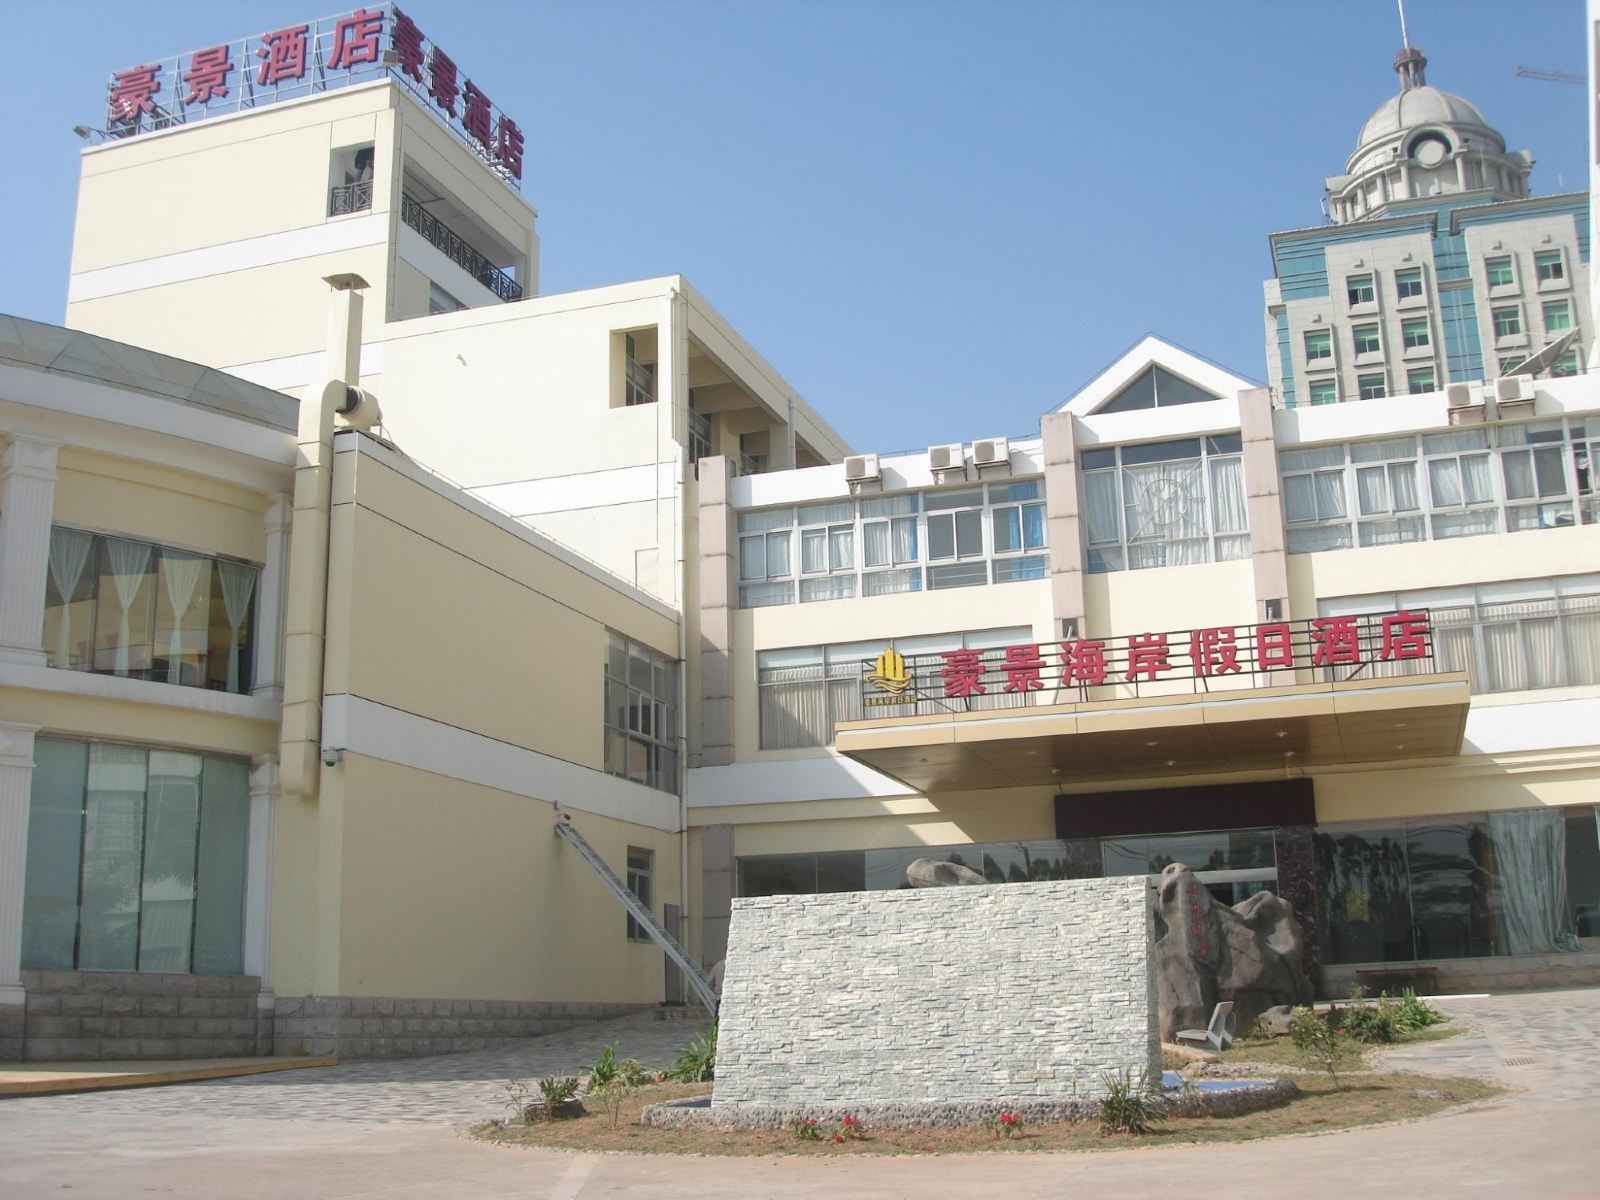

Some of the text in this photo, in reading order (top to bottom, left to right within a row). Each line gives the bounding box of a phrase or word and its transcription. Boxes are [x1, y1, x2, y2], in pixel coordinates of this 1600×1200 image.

[111, 8, 385, 121] 豪景酒店
[391, 6, 525, 181] 豪景酒店
[940, 610, 1430, 699] 豪景海岸假日酒店
